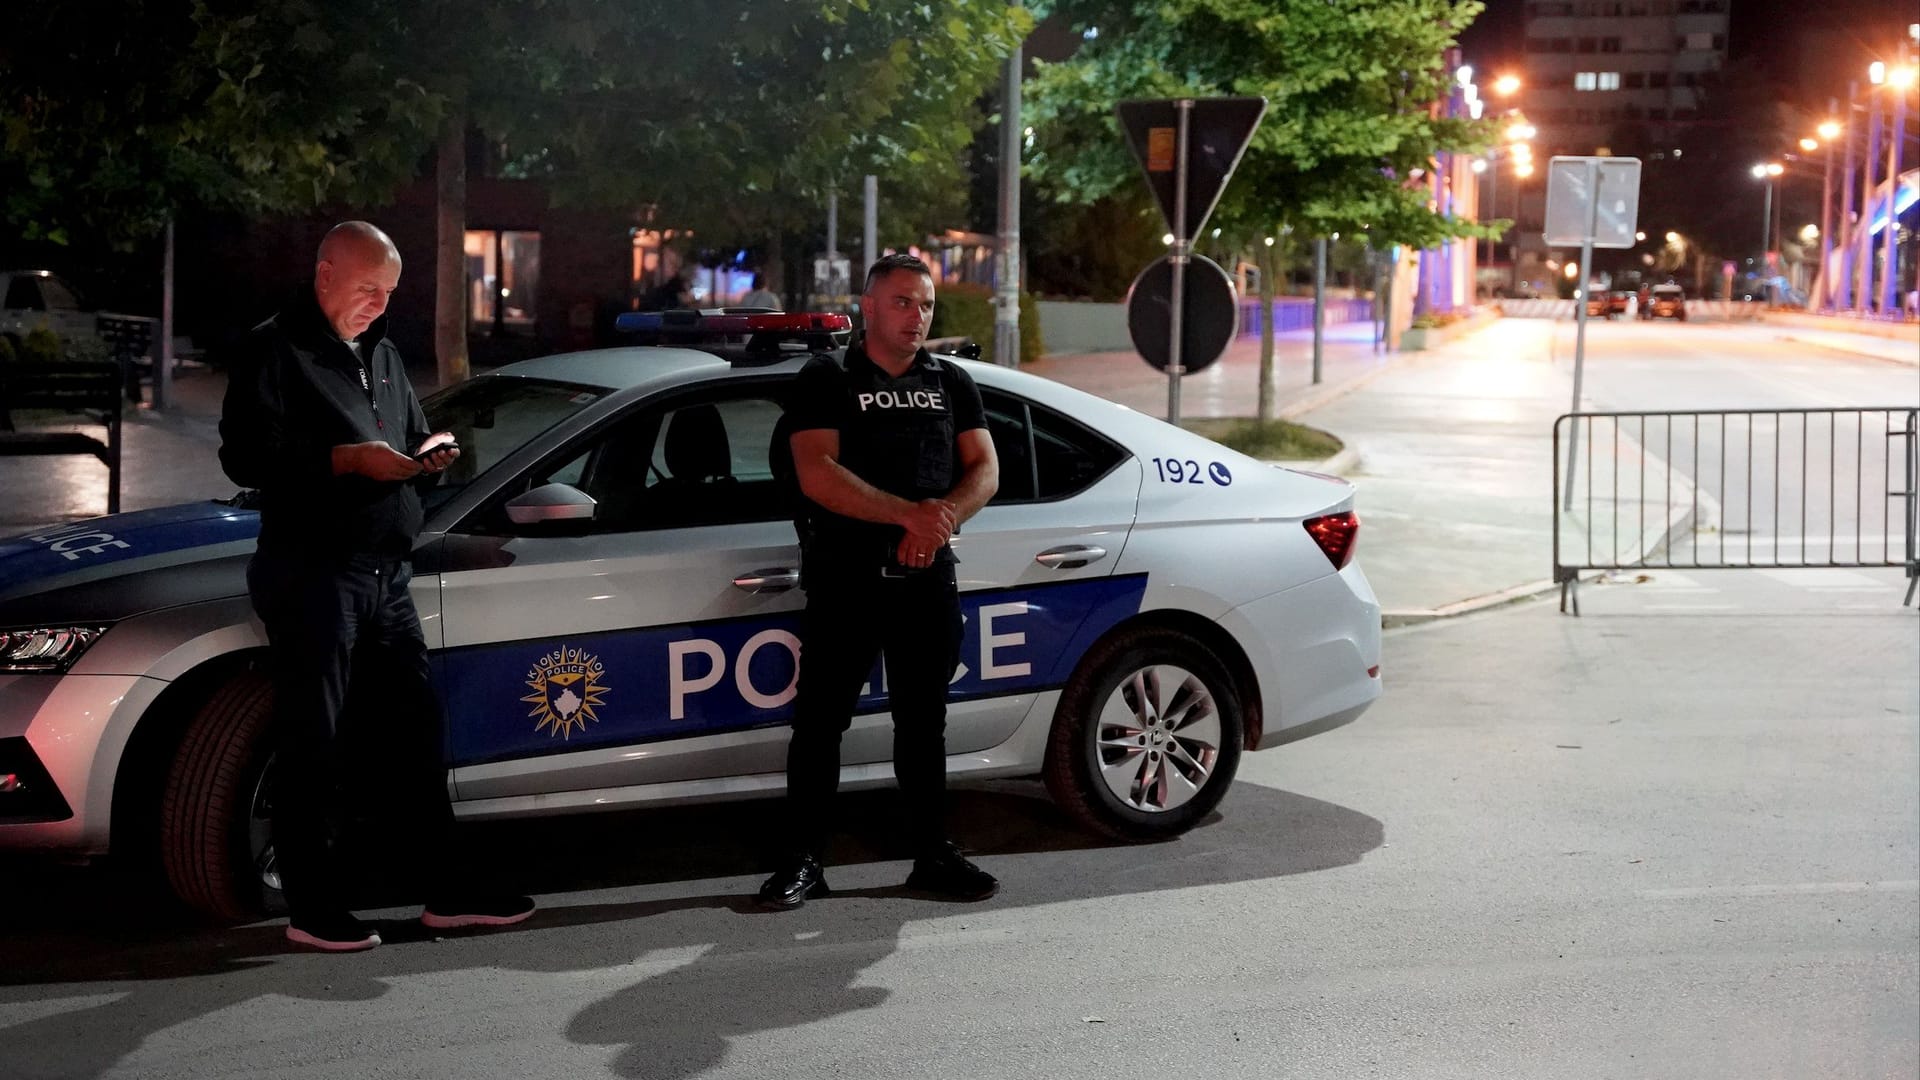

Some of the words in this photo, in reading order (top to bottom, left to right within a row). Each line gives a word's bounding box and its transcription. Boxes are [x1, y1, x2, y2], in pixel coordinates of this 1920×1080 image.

[359, 368, 369, 390] TOMMY
[858, 391, 945, 411] POLICE
[1152, 457, 1204, 484] 192
[20, 524, 131, 560] LICE
[527, 649, 603, 679] KOSOVO
[546, 665, 585, 678] POLICE
[668, 601, 1032, 721] POE
